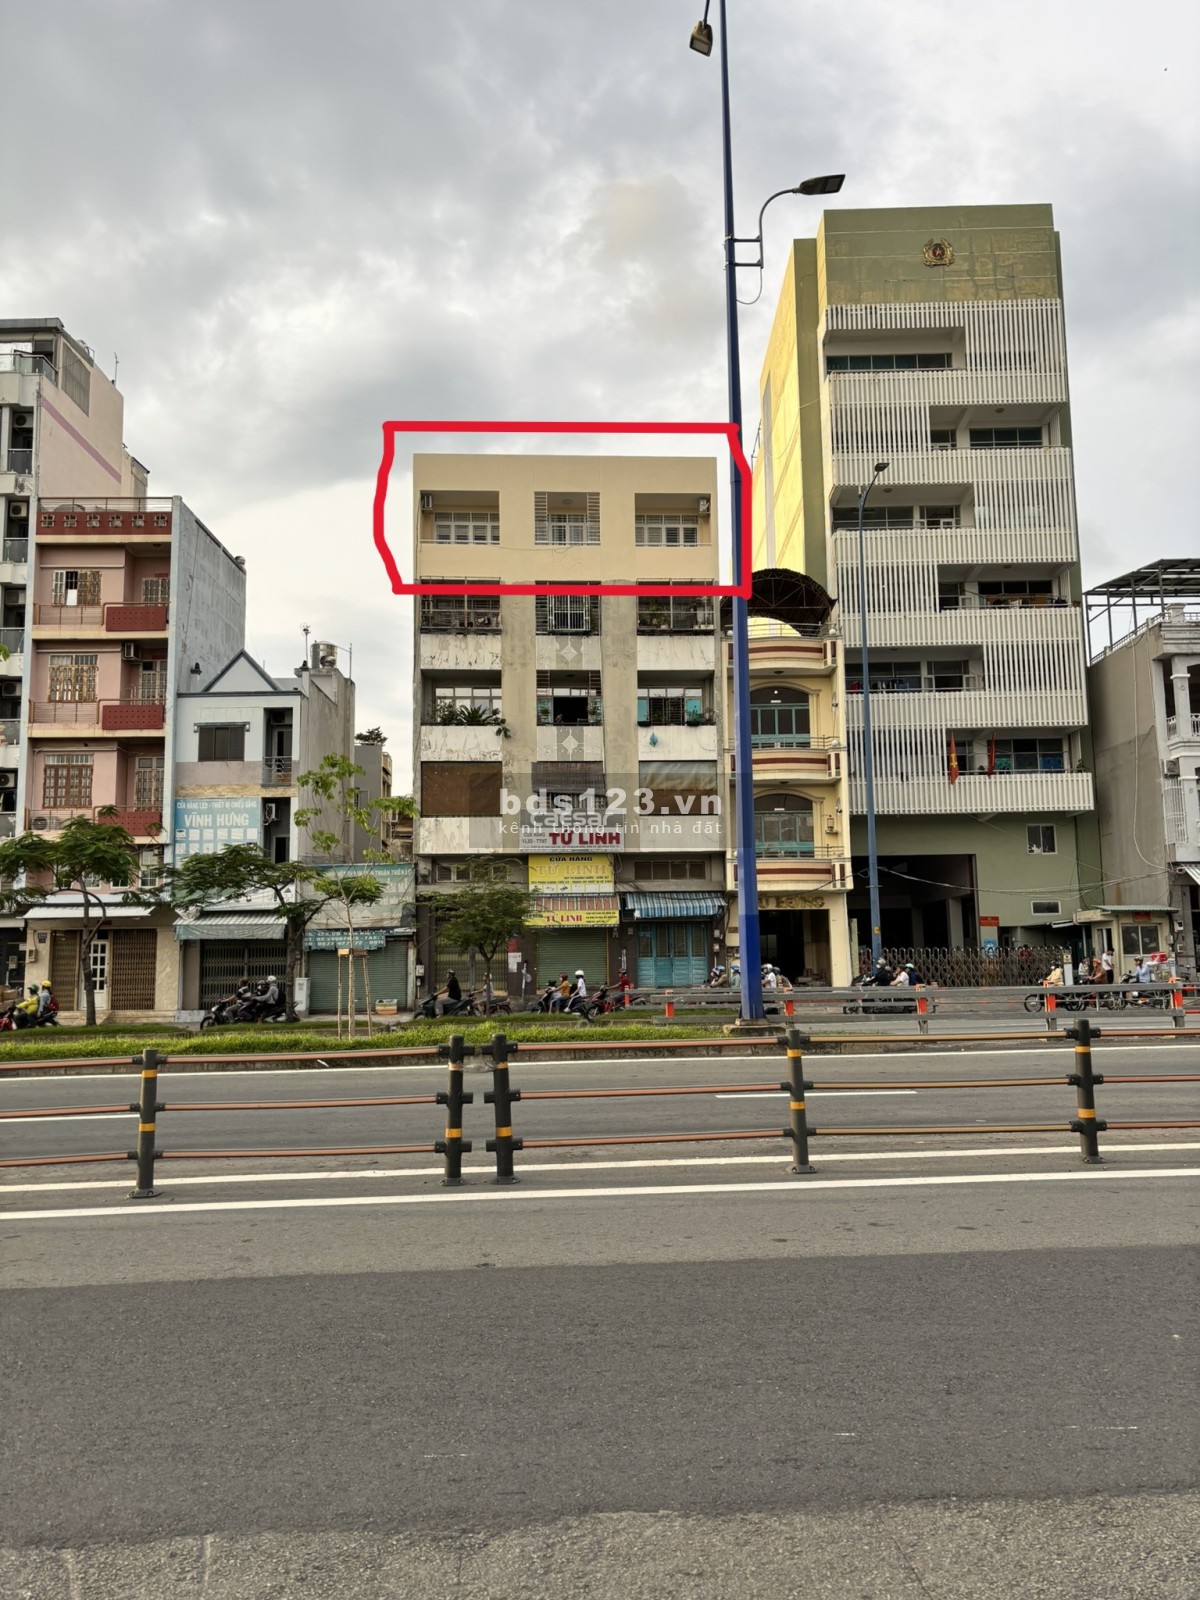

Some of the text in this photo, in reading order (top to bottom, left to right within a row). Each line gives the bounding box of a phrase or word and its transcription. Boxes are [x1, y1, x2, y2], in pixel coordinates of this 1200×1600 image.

[184, 812, 249, 827] VĨNH HƯNG
[578, 832, 621, 845] LINH
[565, 865, 607, 875] LINH
